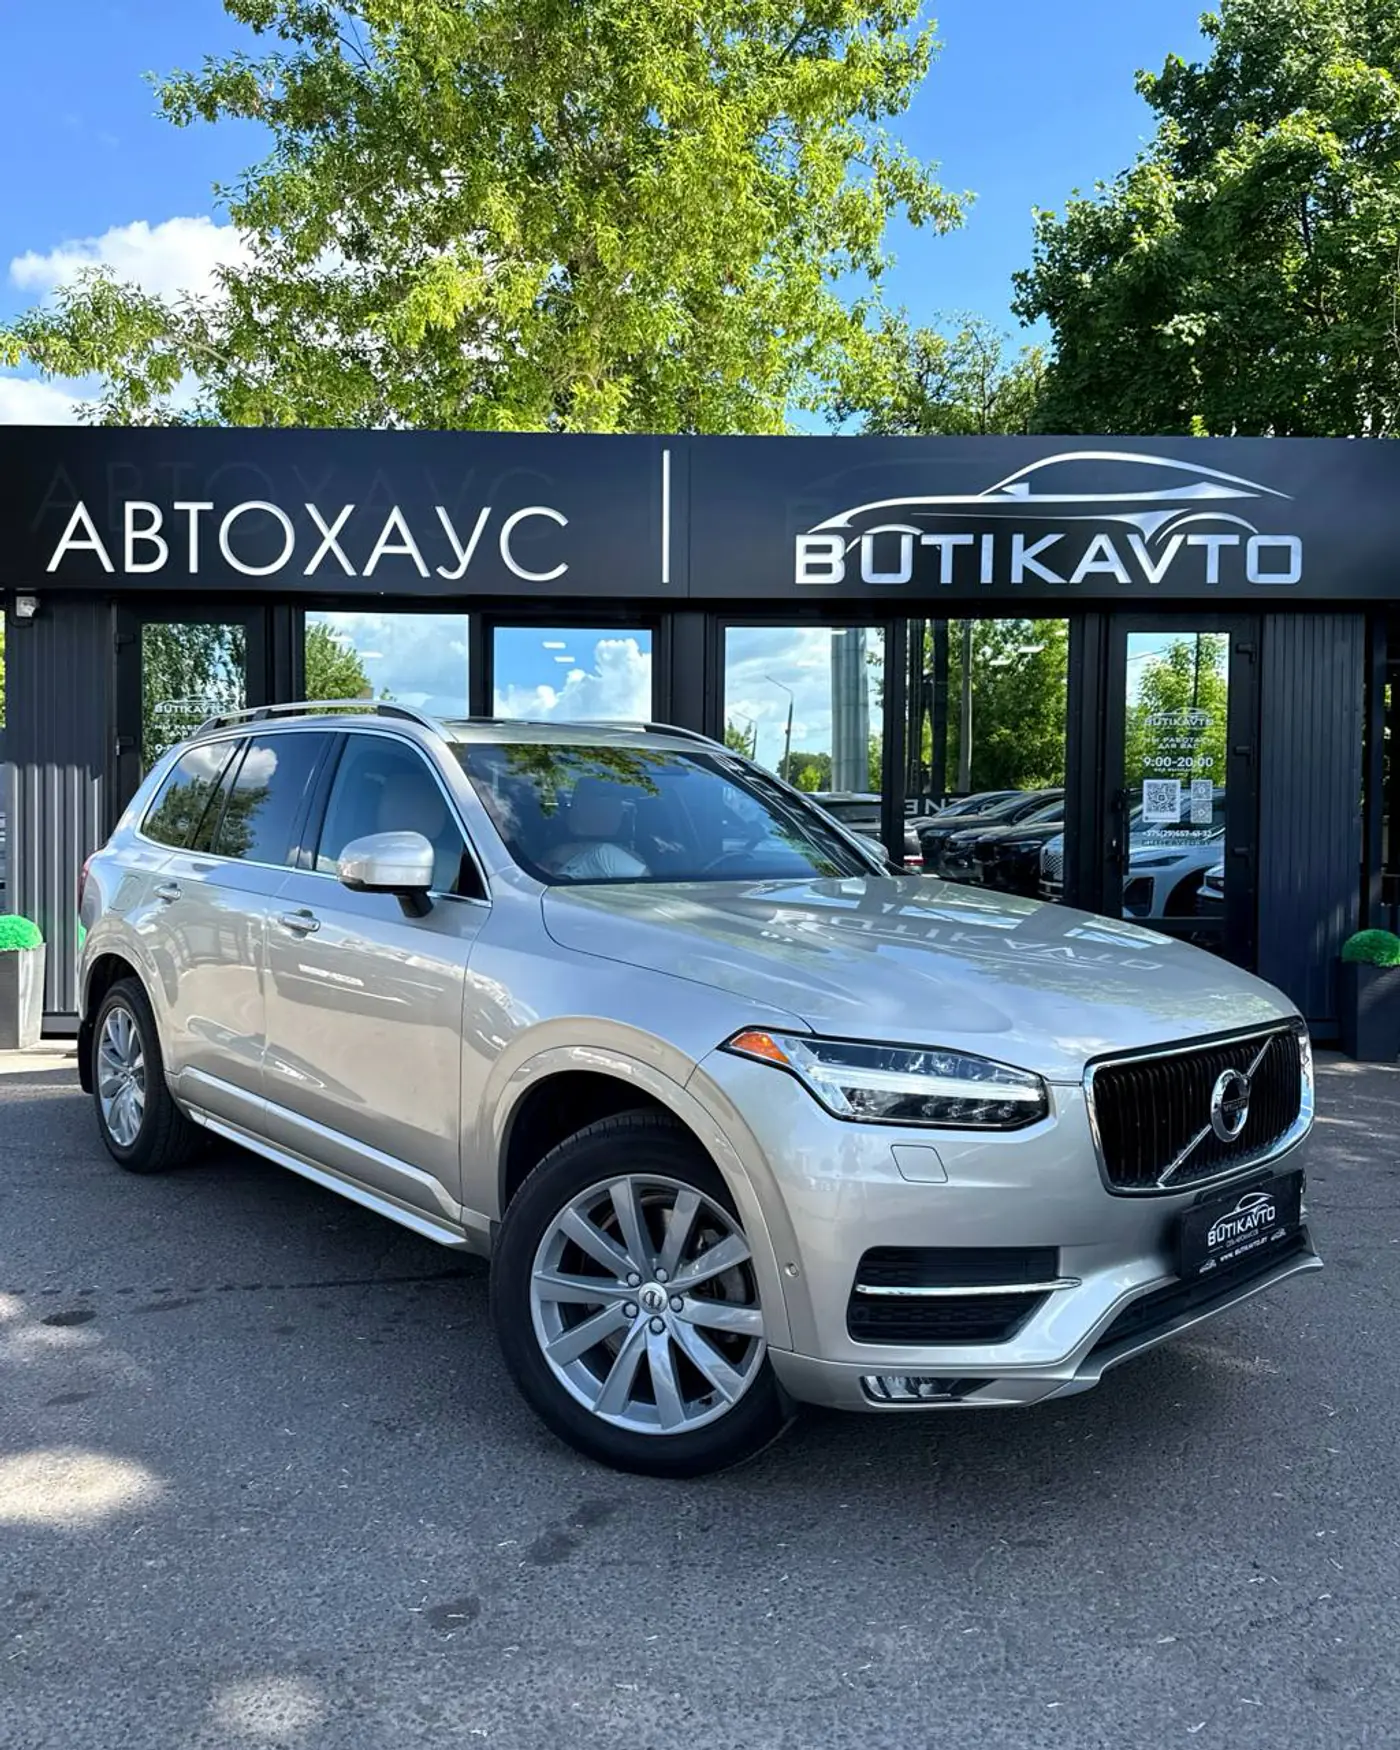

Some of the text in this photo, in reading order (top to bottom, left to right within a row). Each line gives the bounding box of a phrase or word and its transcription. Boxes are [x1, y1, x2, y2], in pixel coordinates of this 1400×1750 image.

[46, 500, 570, 582] АВТОХАУС
[795, 533, 1303, 585] BUTIKAVTO
[154, 705, 226, 713] BUTIKAVTO
[1207, 1205, 1276, 1247] BUTIKAVTO
